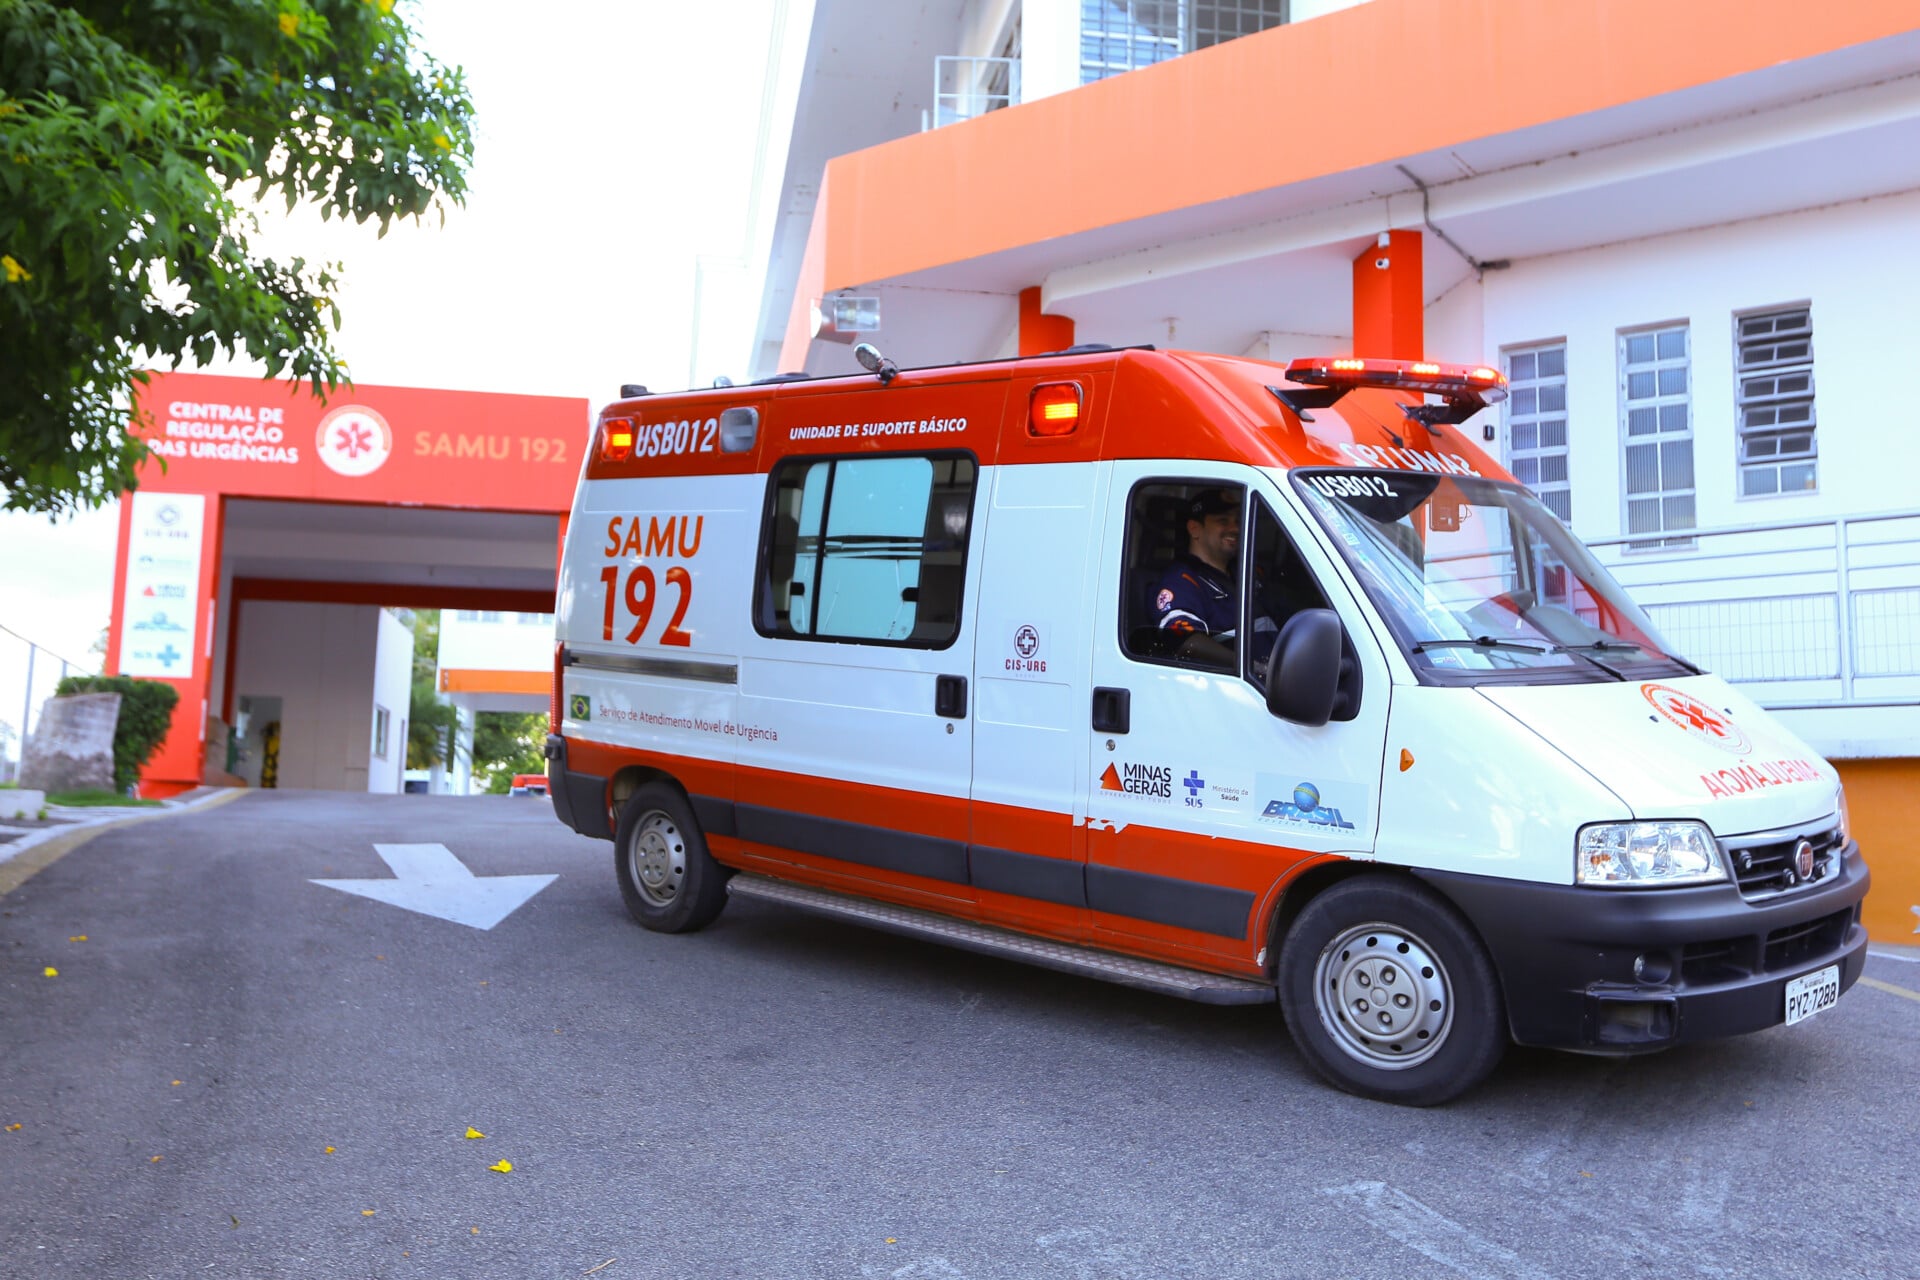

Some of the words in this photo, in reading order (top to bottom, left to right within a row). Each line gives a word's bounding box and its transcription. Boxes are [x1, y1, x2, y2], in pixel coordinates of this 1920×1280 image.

[169, 401, 255, 422] CENTRAL
[259, 407, 284, 424] DE
[166, 420, 284, 445] REGULAÇÃO
[635, 418, 718, 458] USB012
[789, 425, 841, 440] UNIDADE
[843, 424, 859, 438] DE
[861, 420, 916, 436] SUPORTE
[918, 415, 967, 434] BÁSICO
[147, 439, 187, 458] DAS
[190, 440, 299, 464] URGÊNCIAS
[413, 431, 510, 461] SAMU
[519, 437, 568, 463] 192
[1308, 475, 1399, 498] USB012
[604, 515, 704, 558] SAMU
[600, 565, 693, 647] 192
[1005, 658, 1047, 673] CIS-URG
[599, 704, 626, 723] Serviço
[628, 709, 638, 721] de
[639, 711, 693, 729] Atendimento
[723, 721, 735, 735] de
[1123, 762, 1172, 783] MINAS
[1122, 778, 1172, 798] GERAIS
[1184, 797, 1203, 808] SUS
[1261, 800, 1355, 830] BRASIL
